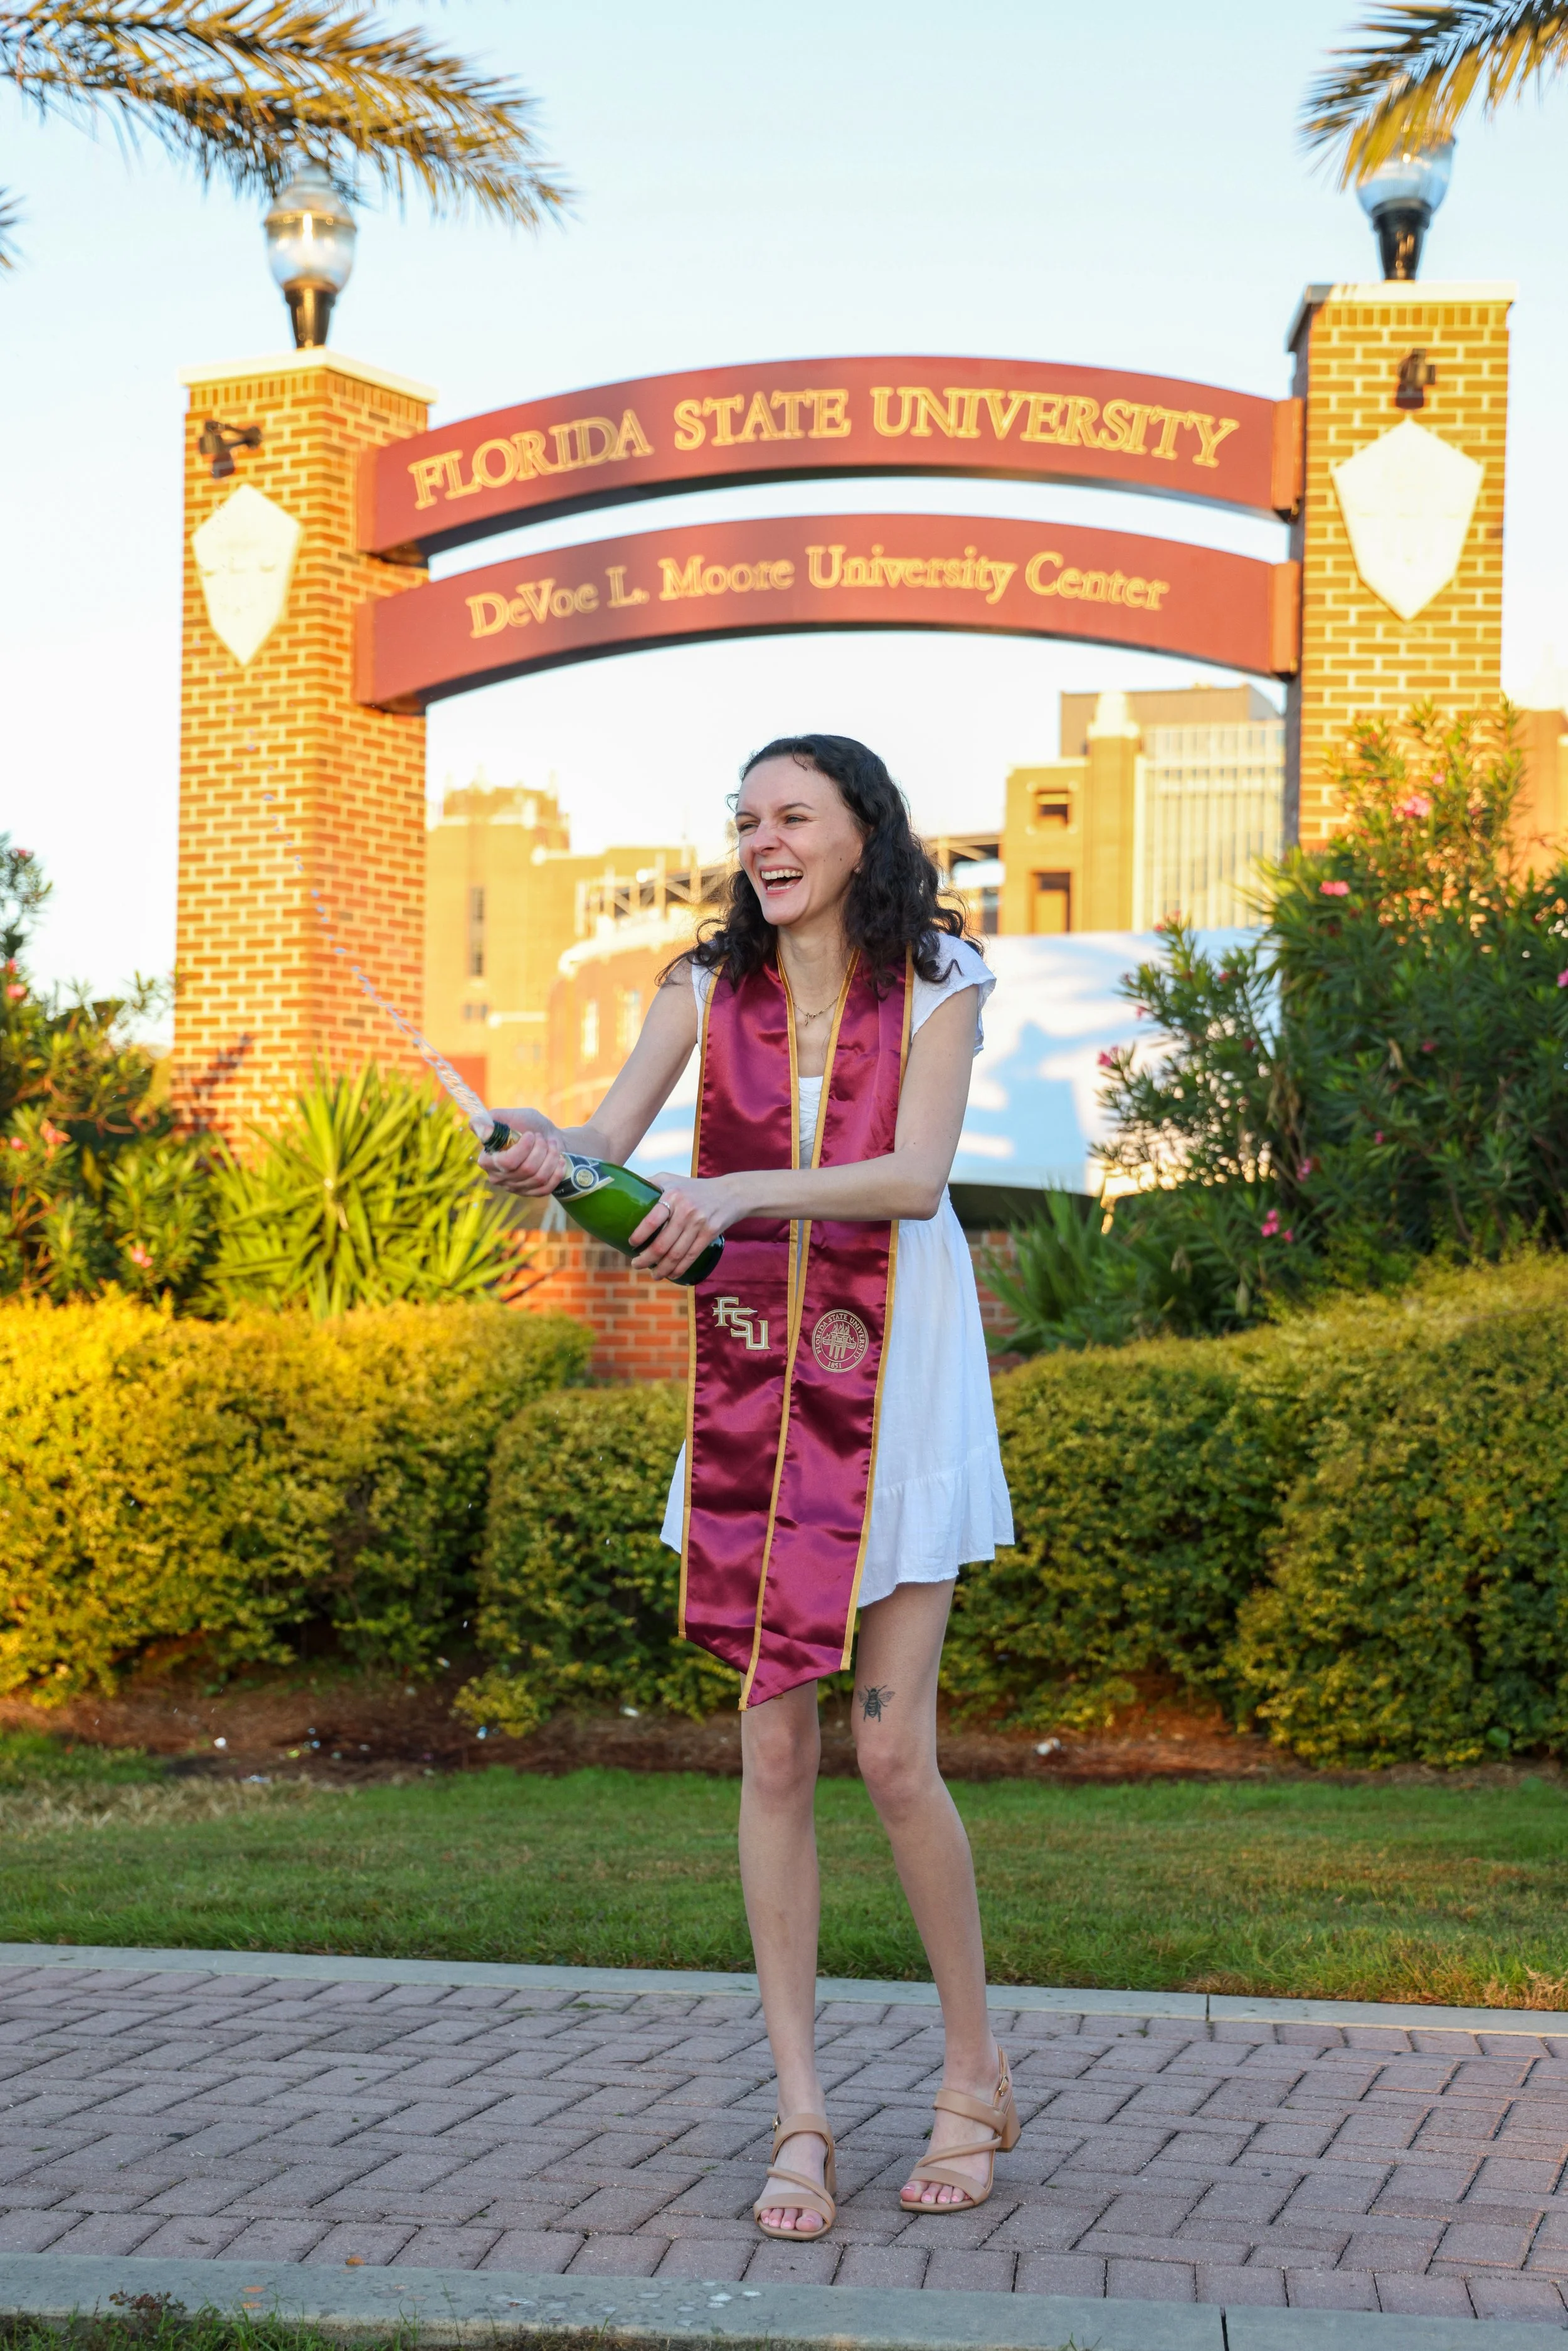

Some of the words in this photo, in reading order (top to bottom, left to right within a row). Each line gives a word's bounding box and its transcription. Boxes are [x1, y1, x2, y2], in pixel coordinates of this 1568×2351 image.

[406, 409, 654, 510] FLORIDA
[673, 388, 851, 451] STATE
[870, 386, 1240, 468] UNIVERSITY
[465, 578, 600, 639] DeVoe
[658, 555, 795, 601] Moore
[805, 544, 1019, 605] University
[1024, 550, 1170, 611] Center
[712, 1297, 771, 1350] FSU
[815, 1321, 828, 1354] FLORIDA
[828, 1313, 848, 1322] STATE
[849, 1317, 865, 1361] UNIVERSITY
